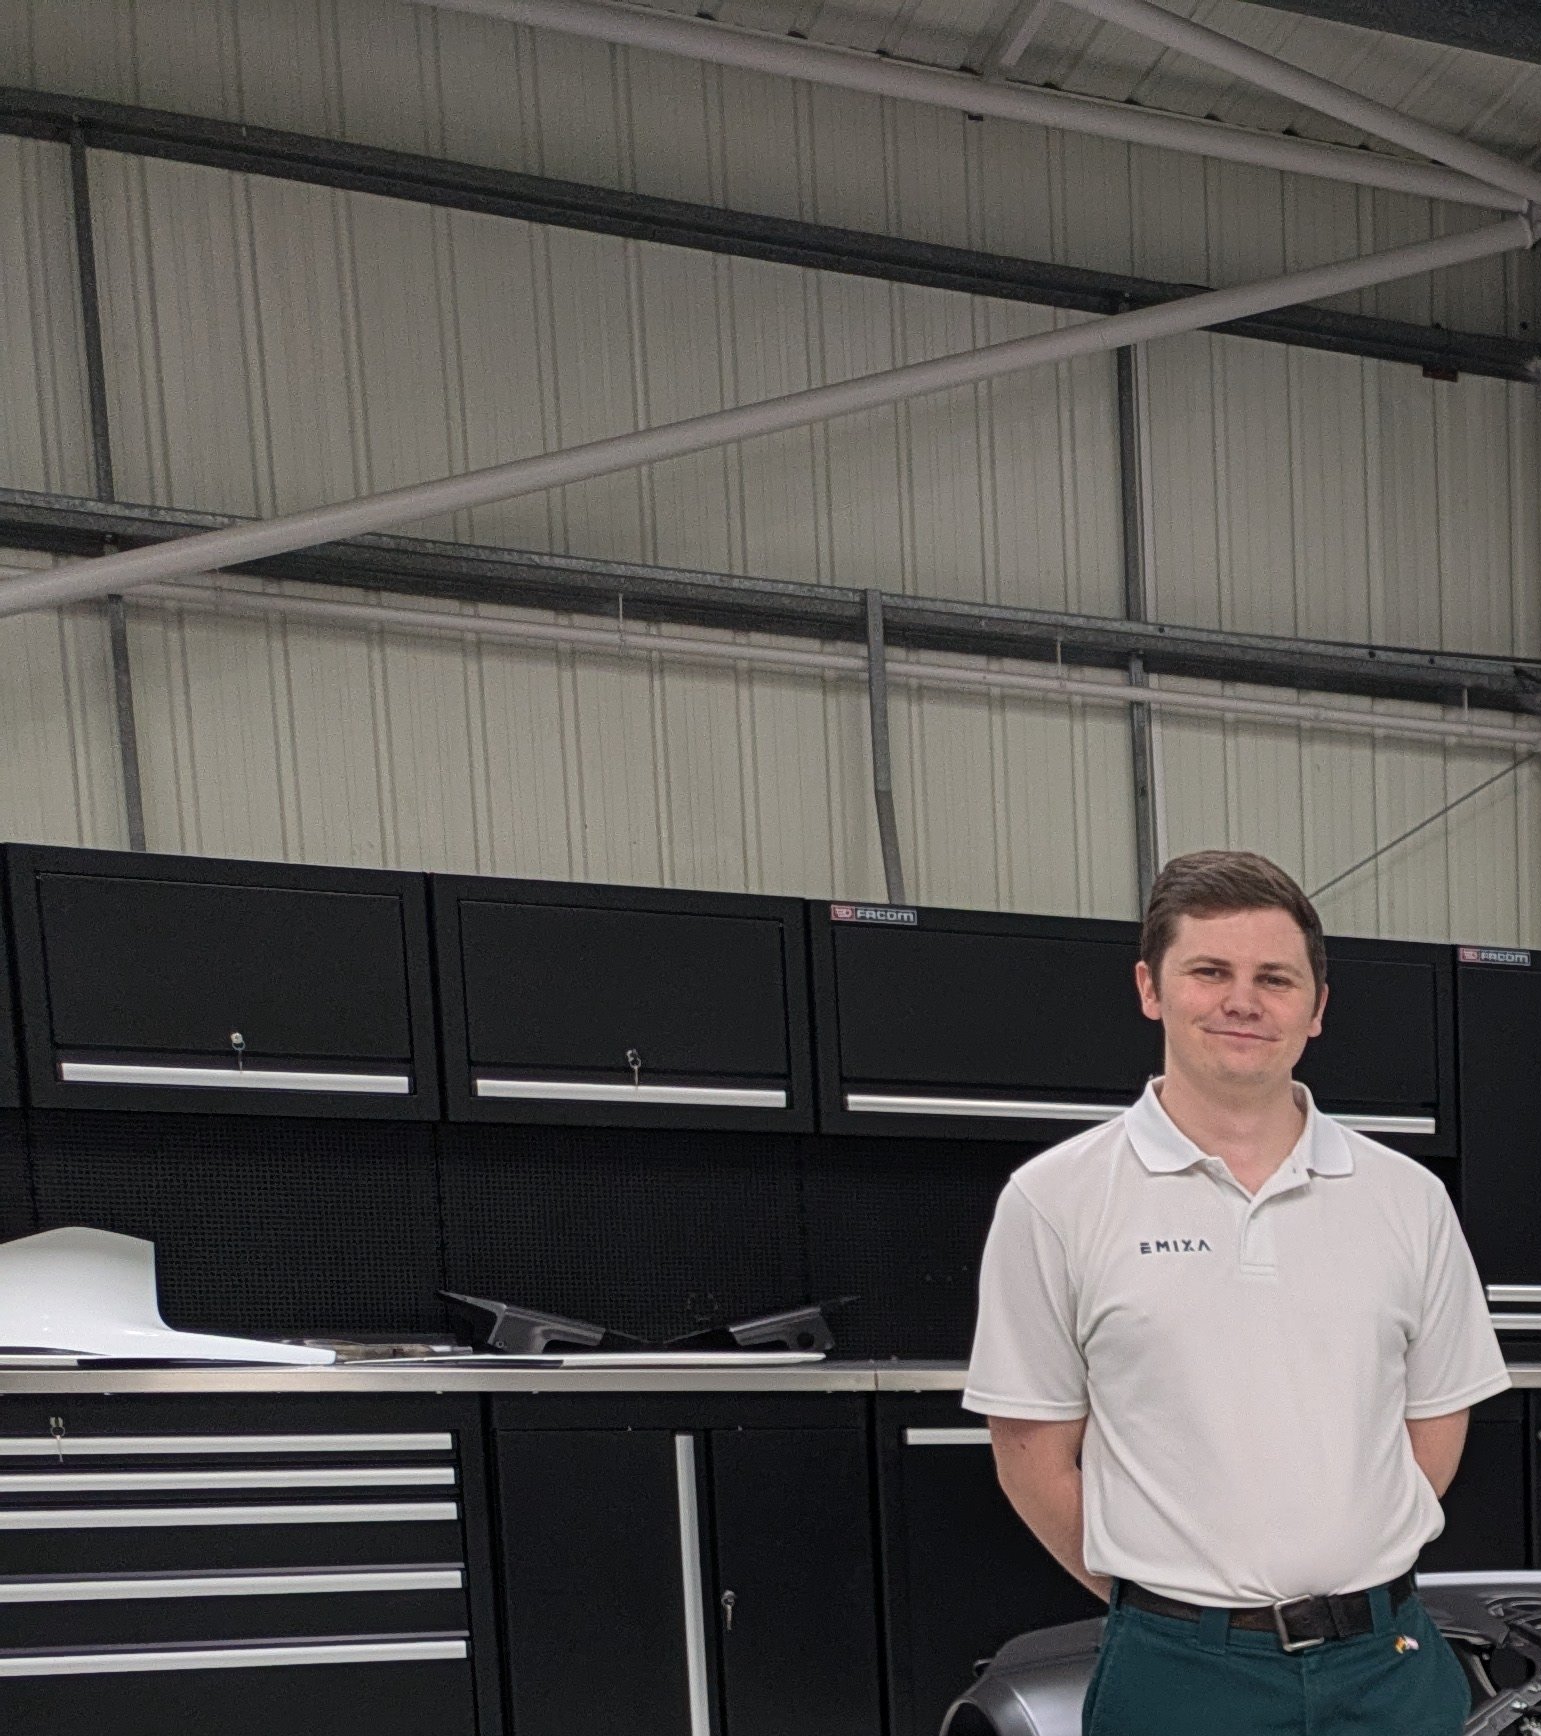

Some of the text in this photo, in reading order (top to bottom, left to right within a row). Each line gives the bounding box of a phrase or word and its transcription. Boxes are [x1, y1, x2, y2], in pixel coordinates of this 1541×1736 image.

[857, 908, 914, 922] FACOM
[1481, 952, 1529, 964] FACOM
[1139, 1239, 1211, 1255] EMIXA
